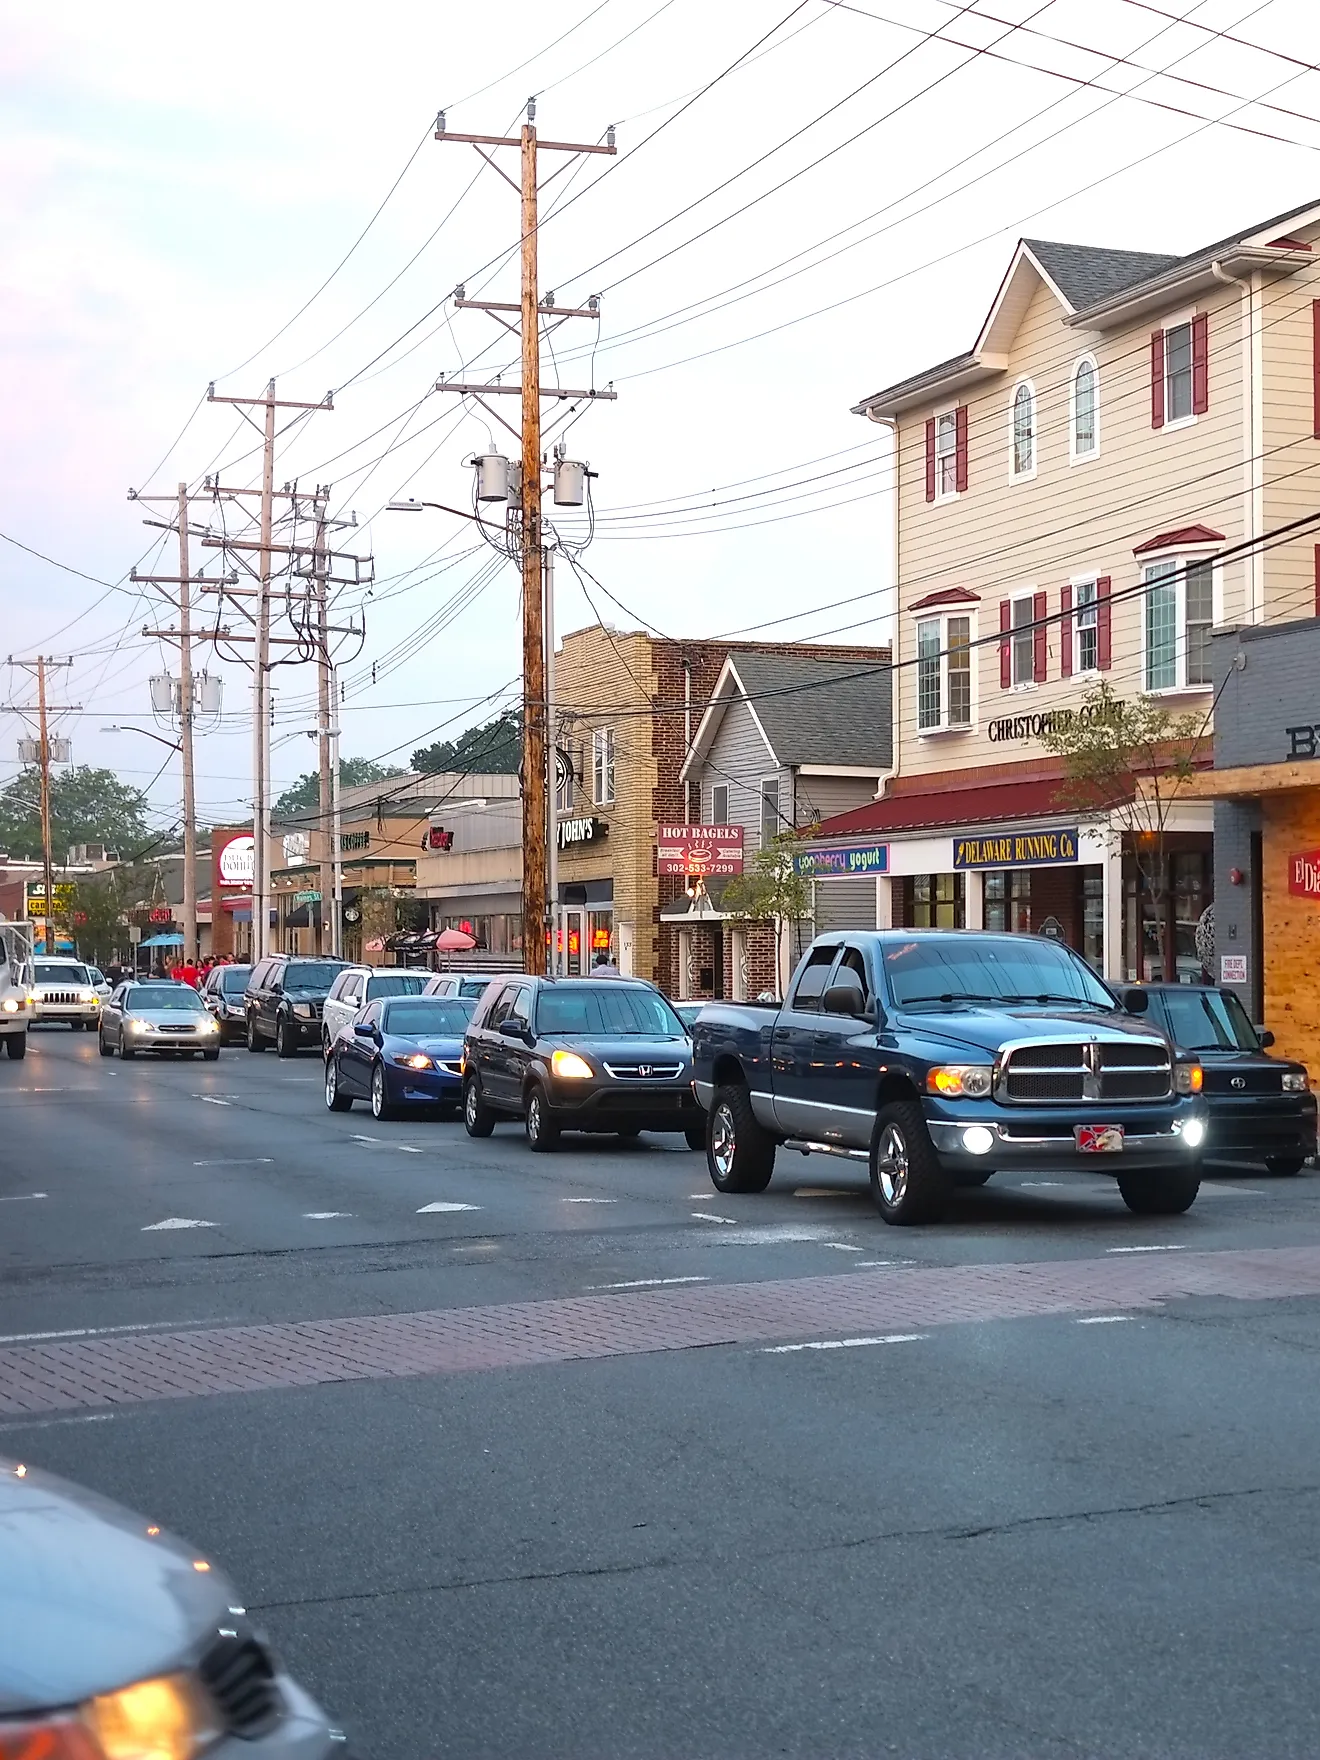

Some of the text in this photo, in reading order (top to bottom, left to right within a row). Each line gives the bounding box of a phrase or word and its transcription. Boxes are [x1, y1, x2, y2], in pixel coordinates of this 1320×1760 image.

[561, 817, 593, 849] JOHN'S
[662, 827, 739, 840] HOT BAGELS
[849, 848, 880, 871] yogurt
[965, 838, 1012, 864] DELAWARE
[1015, 834, 1058, 860] RUNNING
[666, 863, 734, 873] 302-533-7299
[1295, 857, 1304, 883] El
